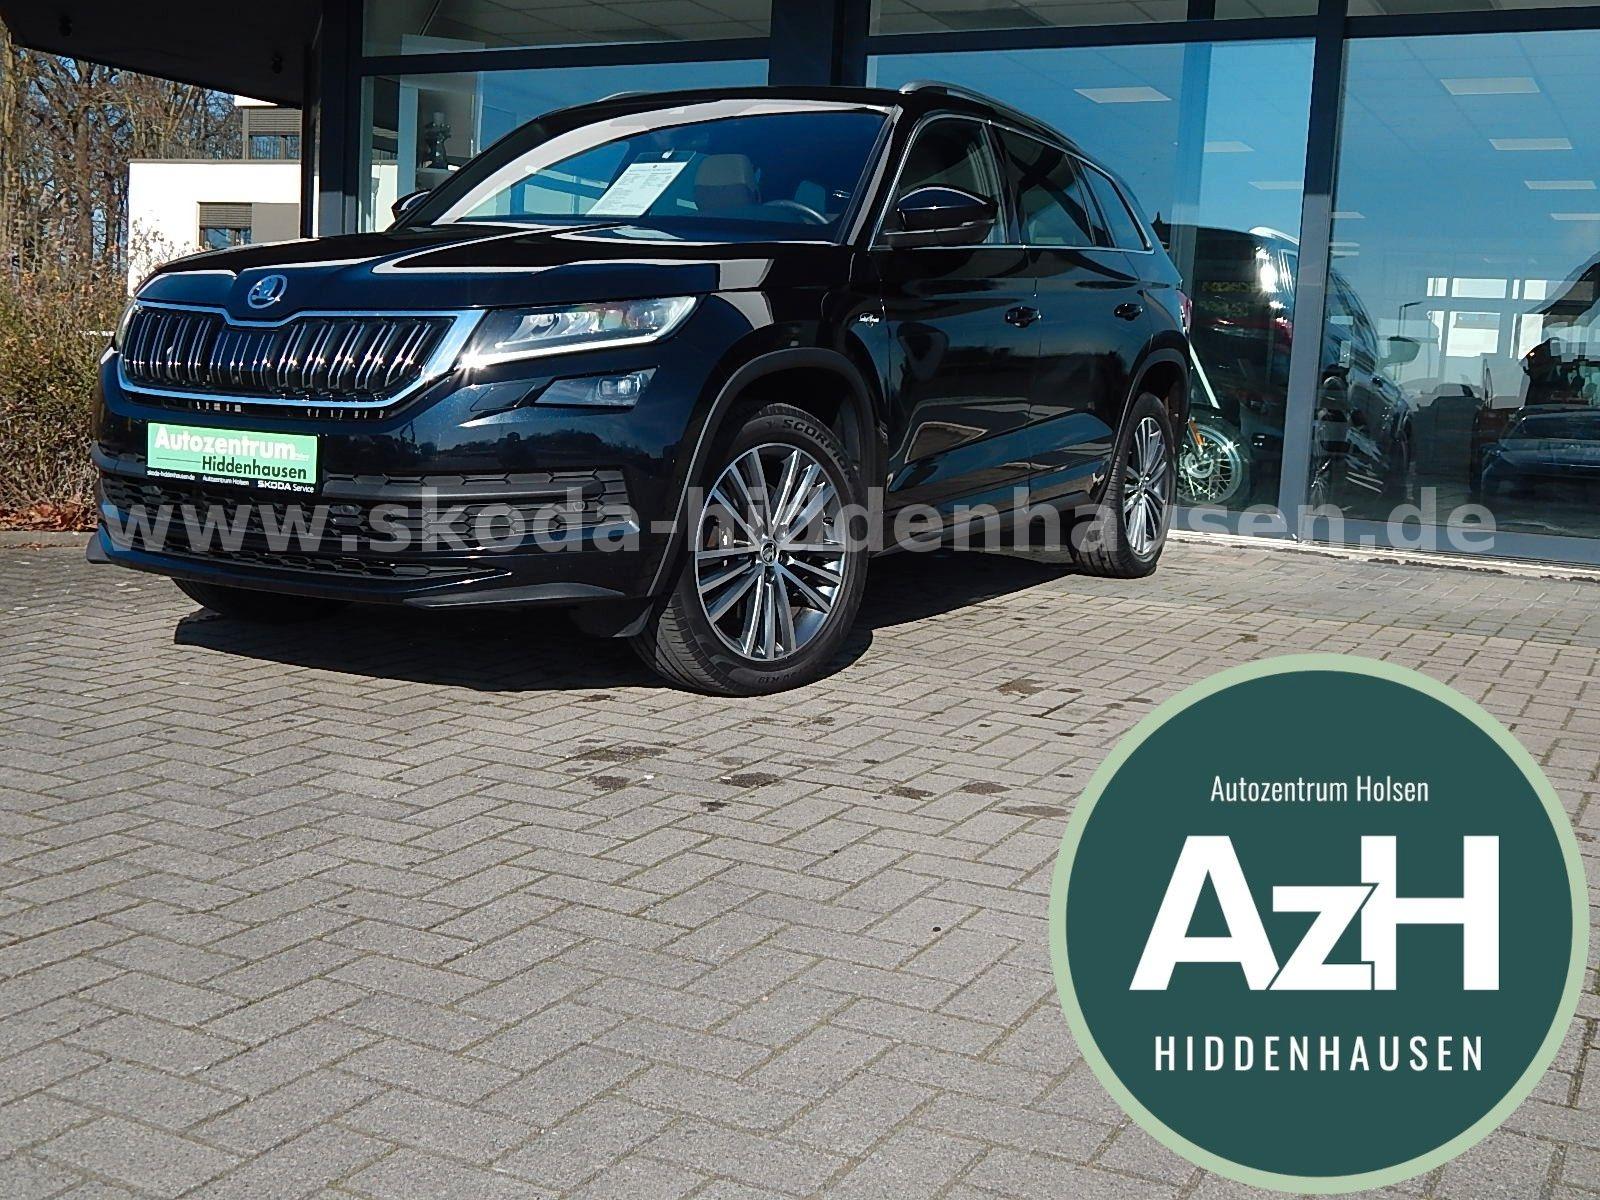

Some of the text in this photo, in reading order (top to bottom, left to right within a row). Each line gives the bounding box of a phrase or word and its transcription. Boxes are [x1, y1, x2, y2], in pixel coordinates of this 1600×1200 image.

[156, 427, 295, 459] Autozentrum
[202, 456, 307, 479] Hiddenhausen
[203, 475, 232, 484] Autozentrum
[292, 484, 314, 493] Service
